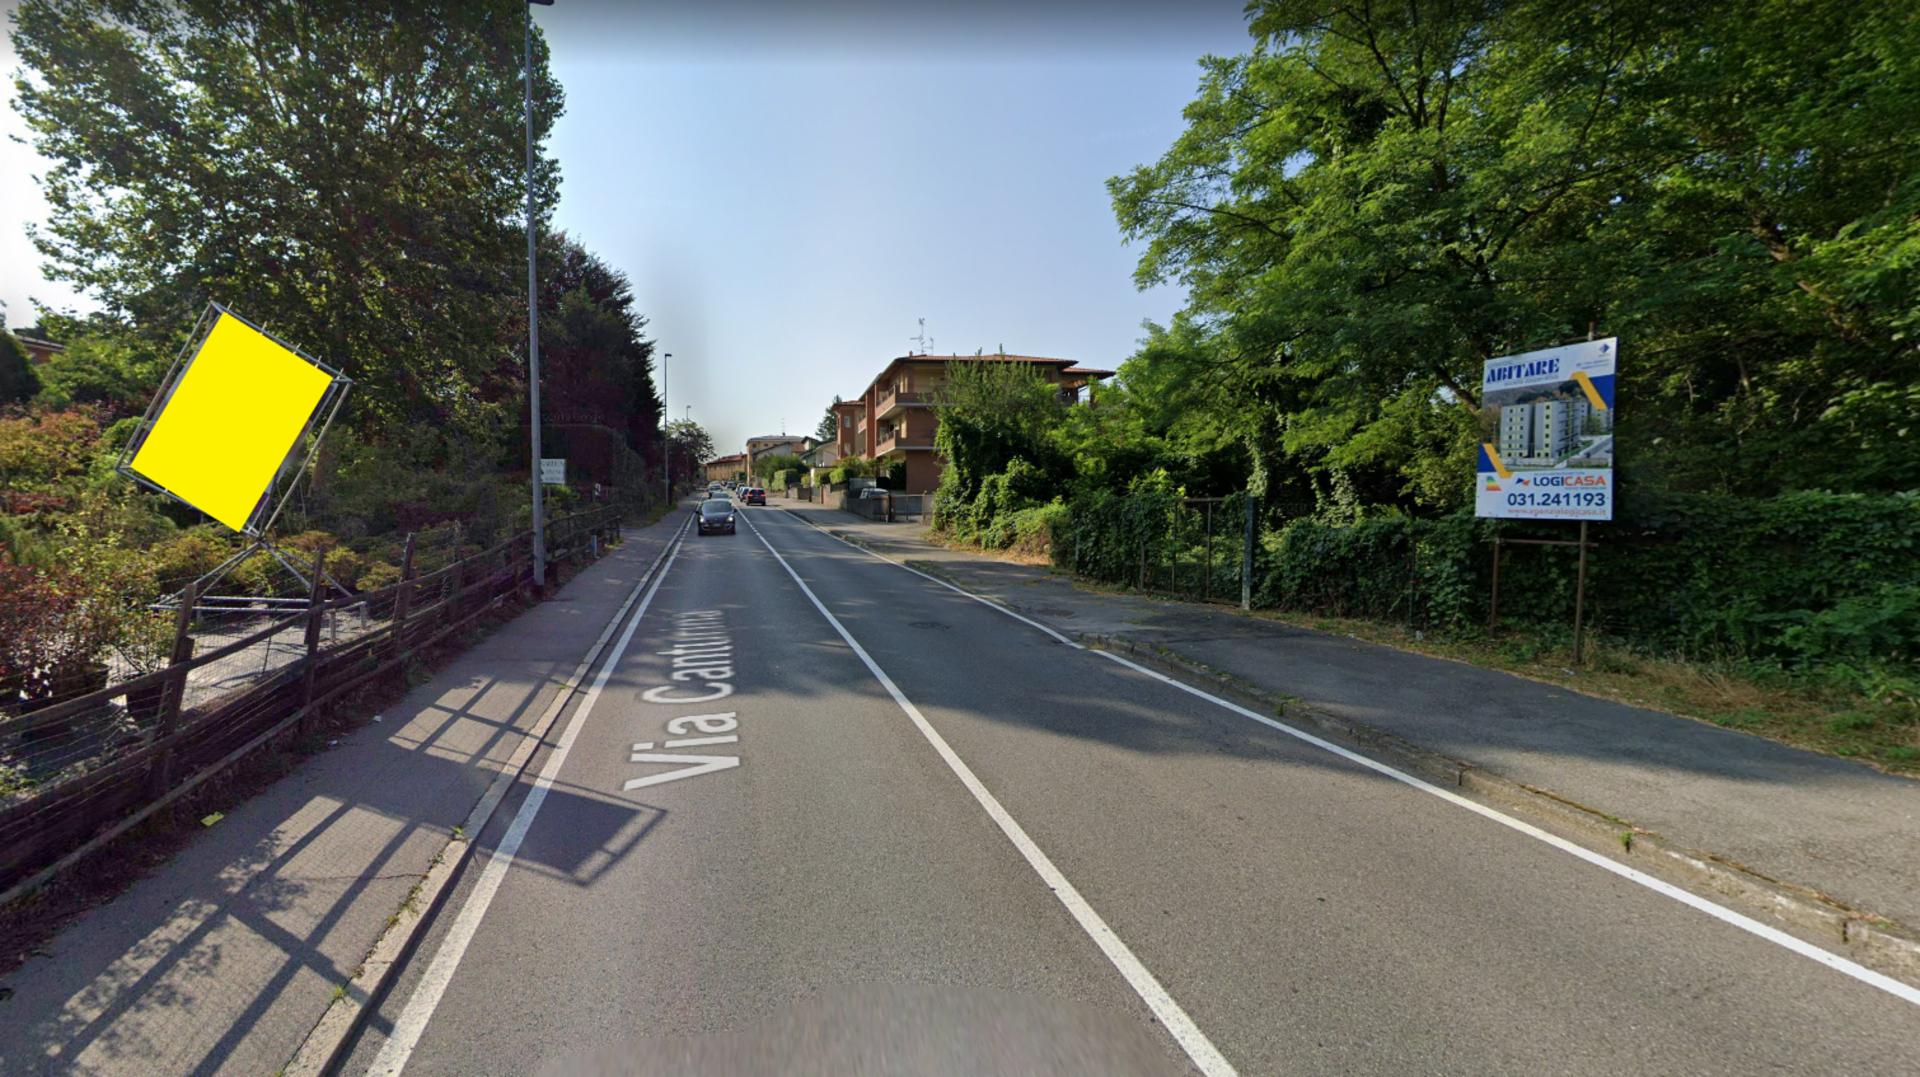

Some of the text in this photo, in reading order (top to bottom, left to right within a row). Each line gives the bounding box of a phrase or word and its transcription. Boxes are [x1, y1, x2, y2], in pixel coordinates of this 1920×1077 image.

[1486, 358, 1560, 383] ABITARE
[1533, 475, 1606, 487] LOGICASA
[1507, 492, 1606, 507] 031.241193
